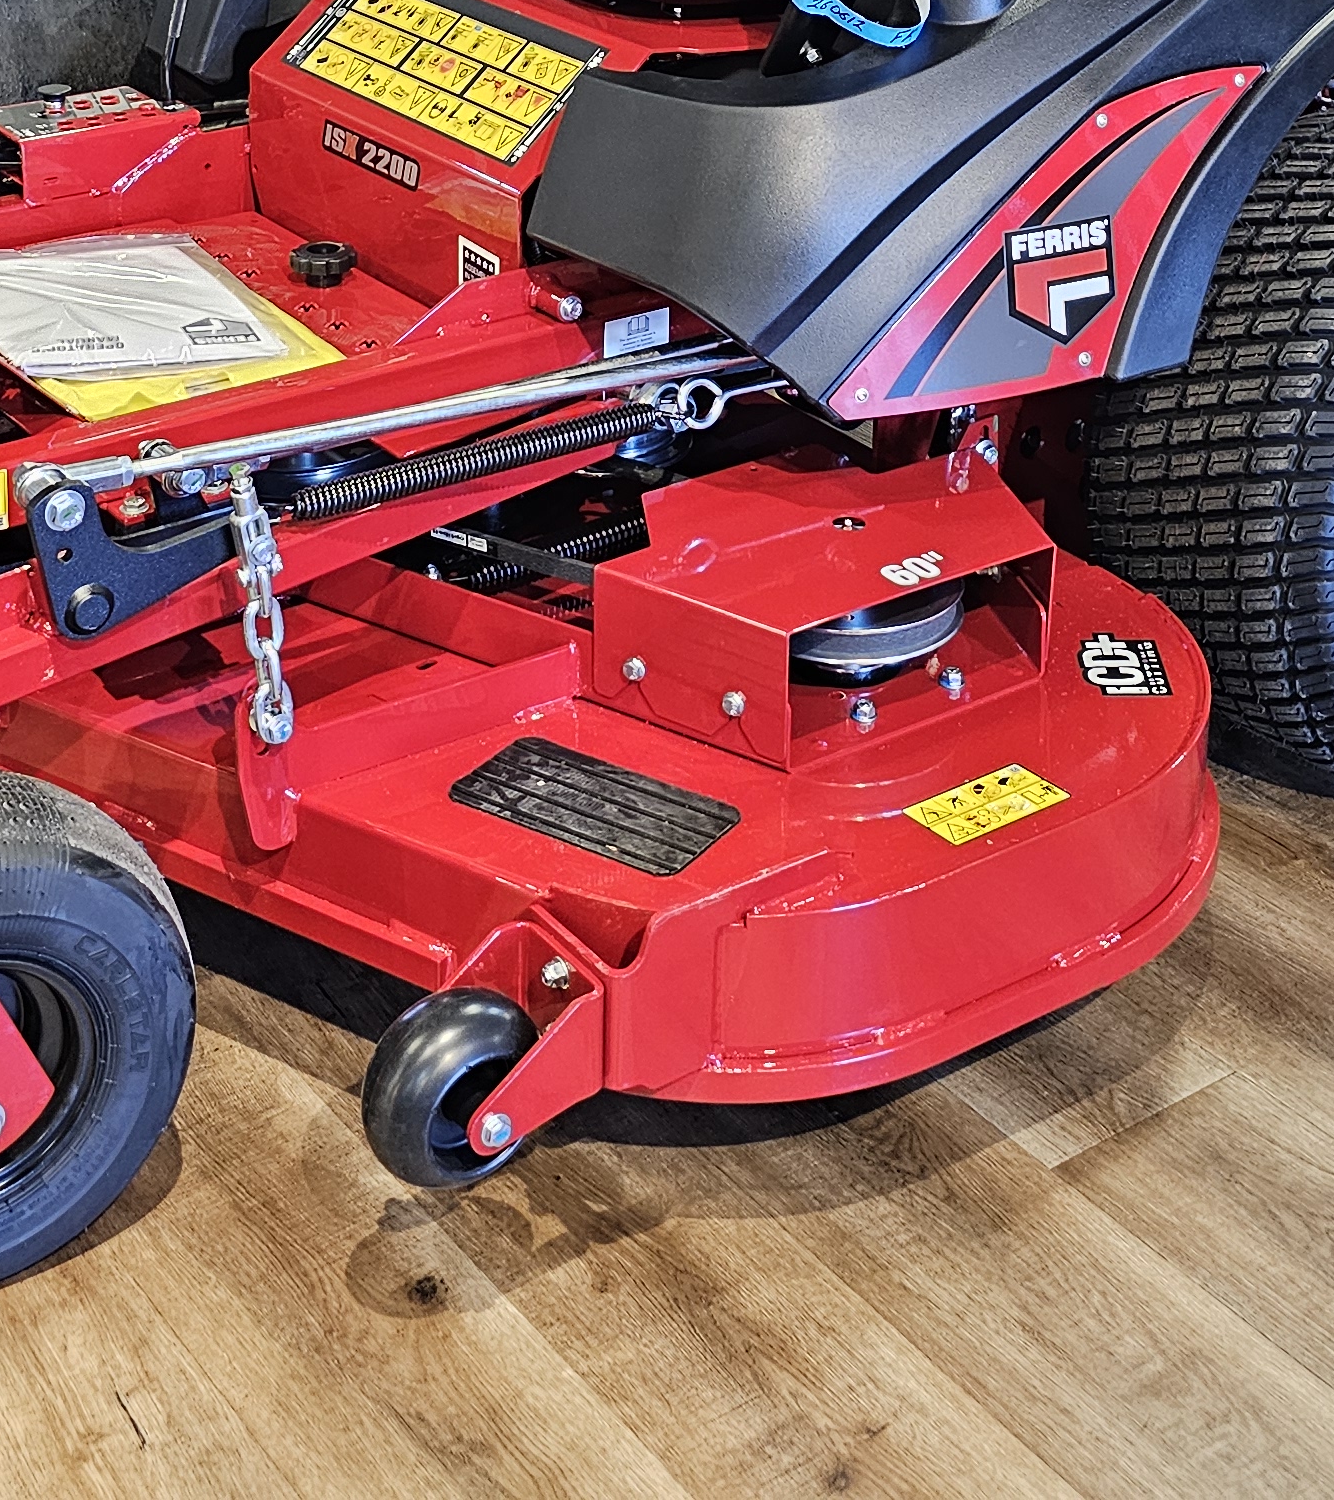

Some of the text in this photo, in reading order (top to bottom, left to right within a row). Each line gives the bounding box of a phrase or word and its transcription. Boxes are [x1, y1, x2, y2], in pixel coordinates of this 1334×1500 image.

[324, 123, 419, 187] ISX 2200
[1011, 220, 1107, 261] FERRIS
